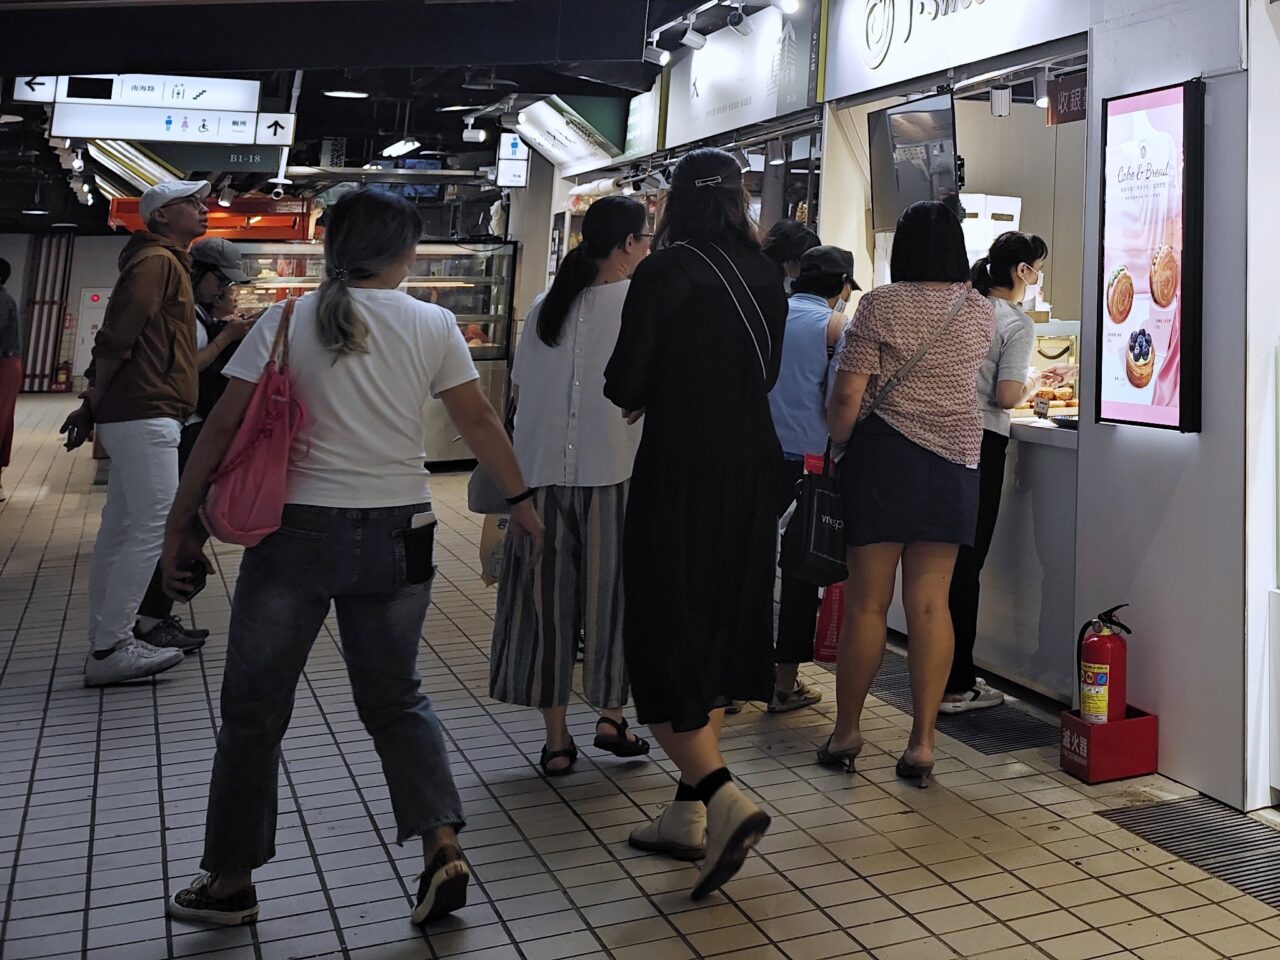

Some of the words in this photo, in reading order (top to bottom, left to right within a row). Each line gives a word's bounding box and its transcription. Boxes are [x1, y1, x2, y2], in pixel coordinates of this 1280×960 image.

[230, 154, 261, 163] B1-18
[1062, 728, 1087, 758] 滅火器
